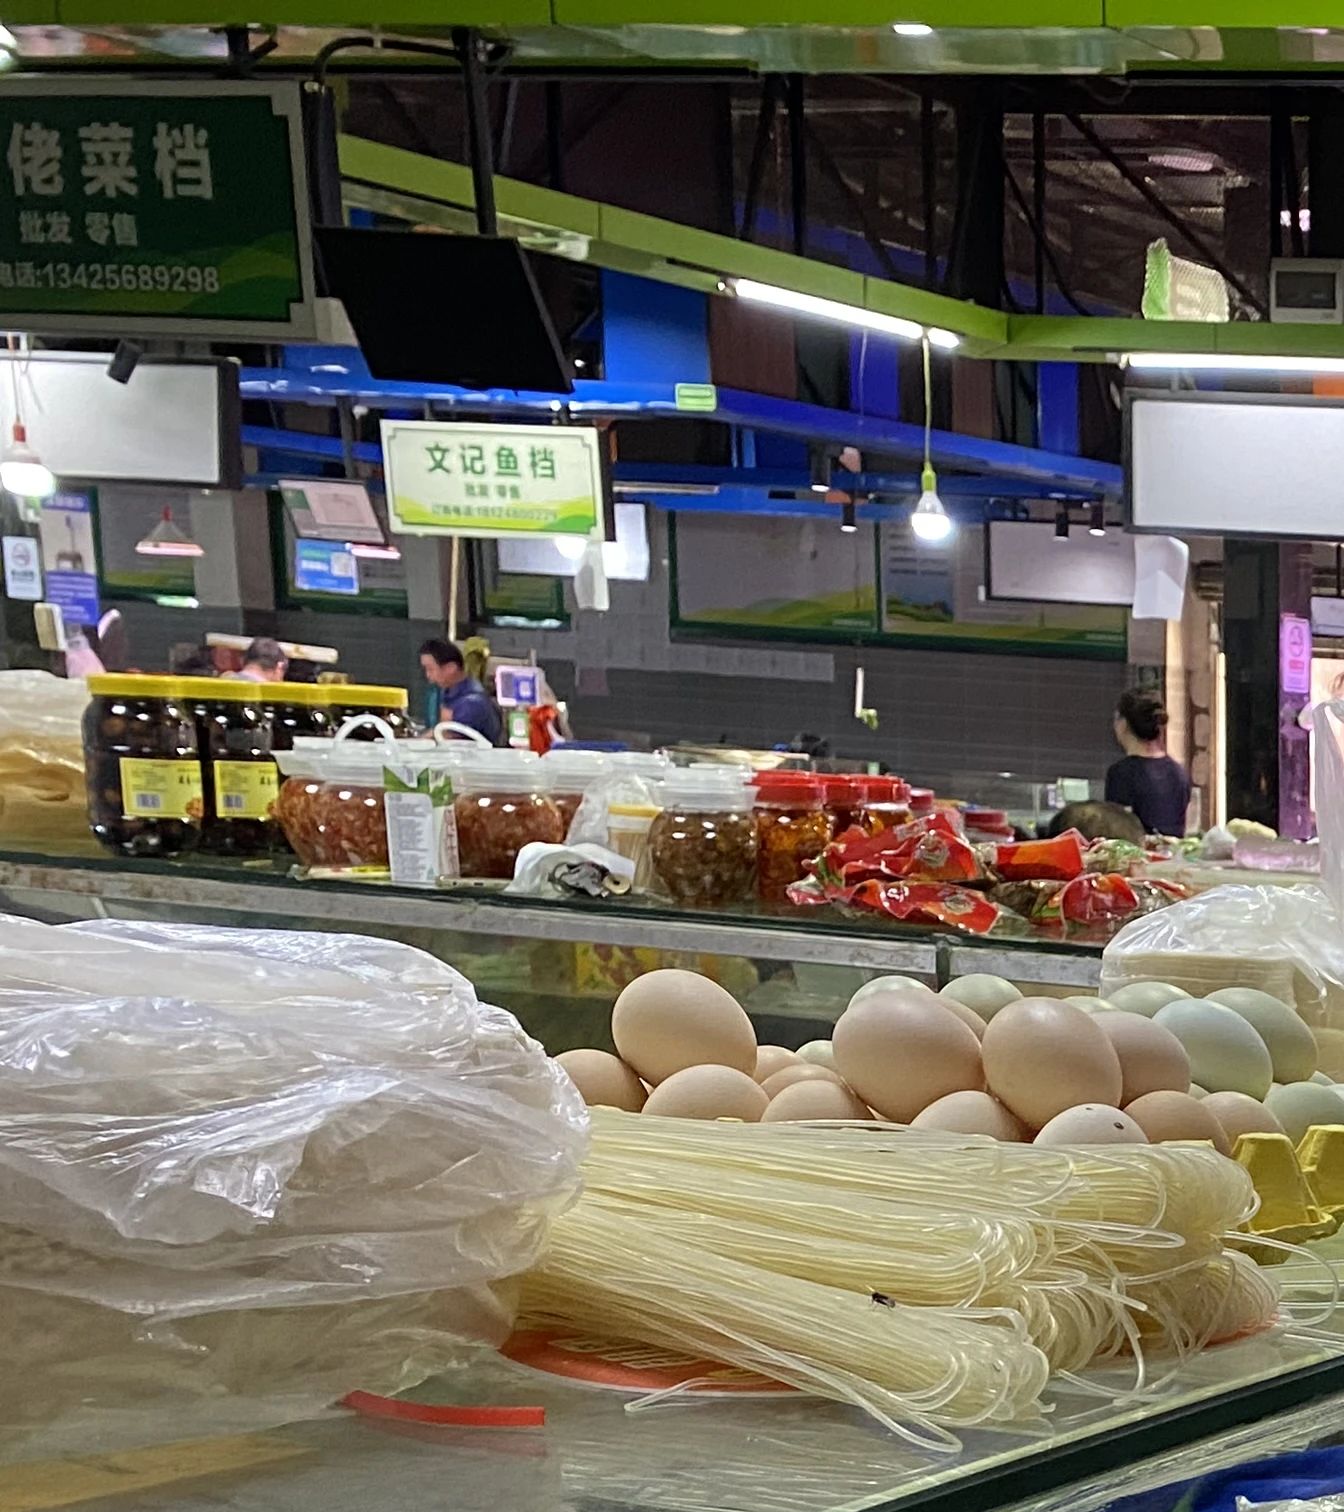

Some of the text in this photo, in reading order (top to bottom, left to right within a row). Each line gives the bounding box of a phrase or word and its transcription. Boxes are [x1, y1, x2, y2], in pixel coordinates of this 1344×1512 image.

[7, 121, 214, 199] 佬菜档
[19, 210, 72, 244] 批发
[425, 441, 556, 480] 文记鱼档
